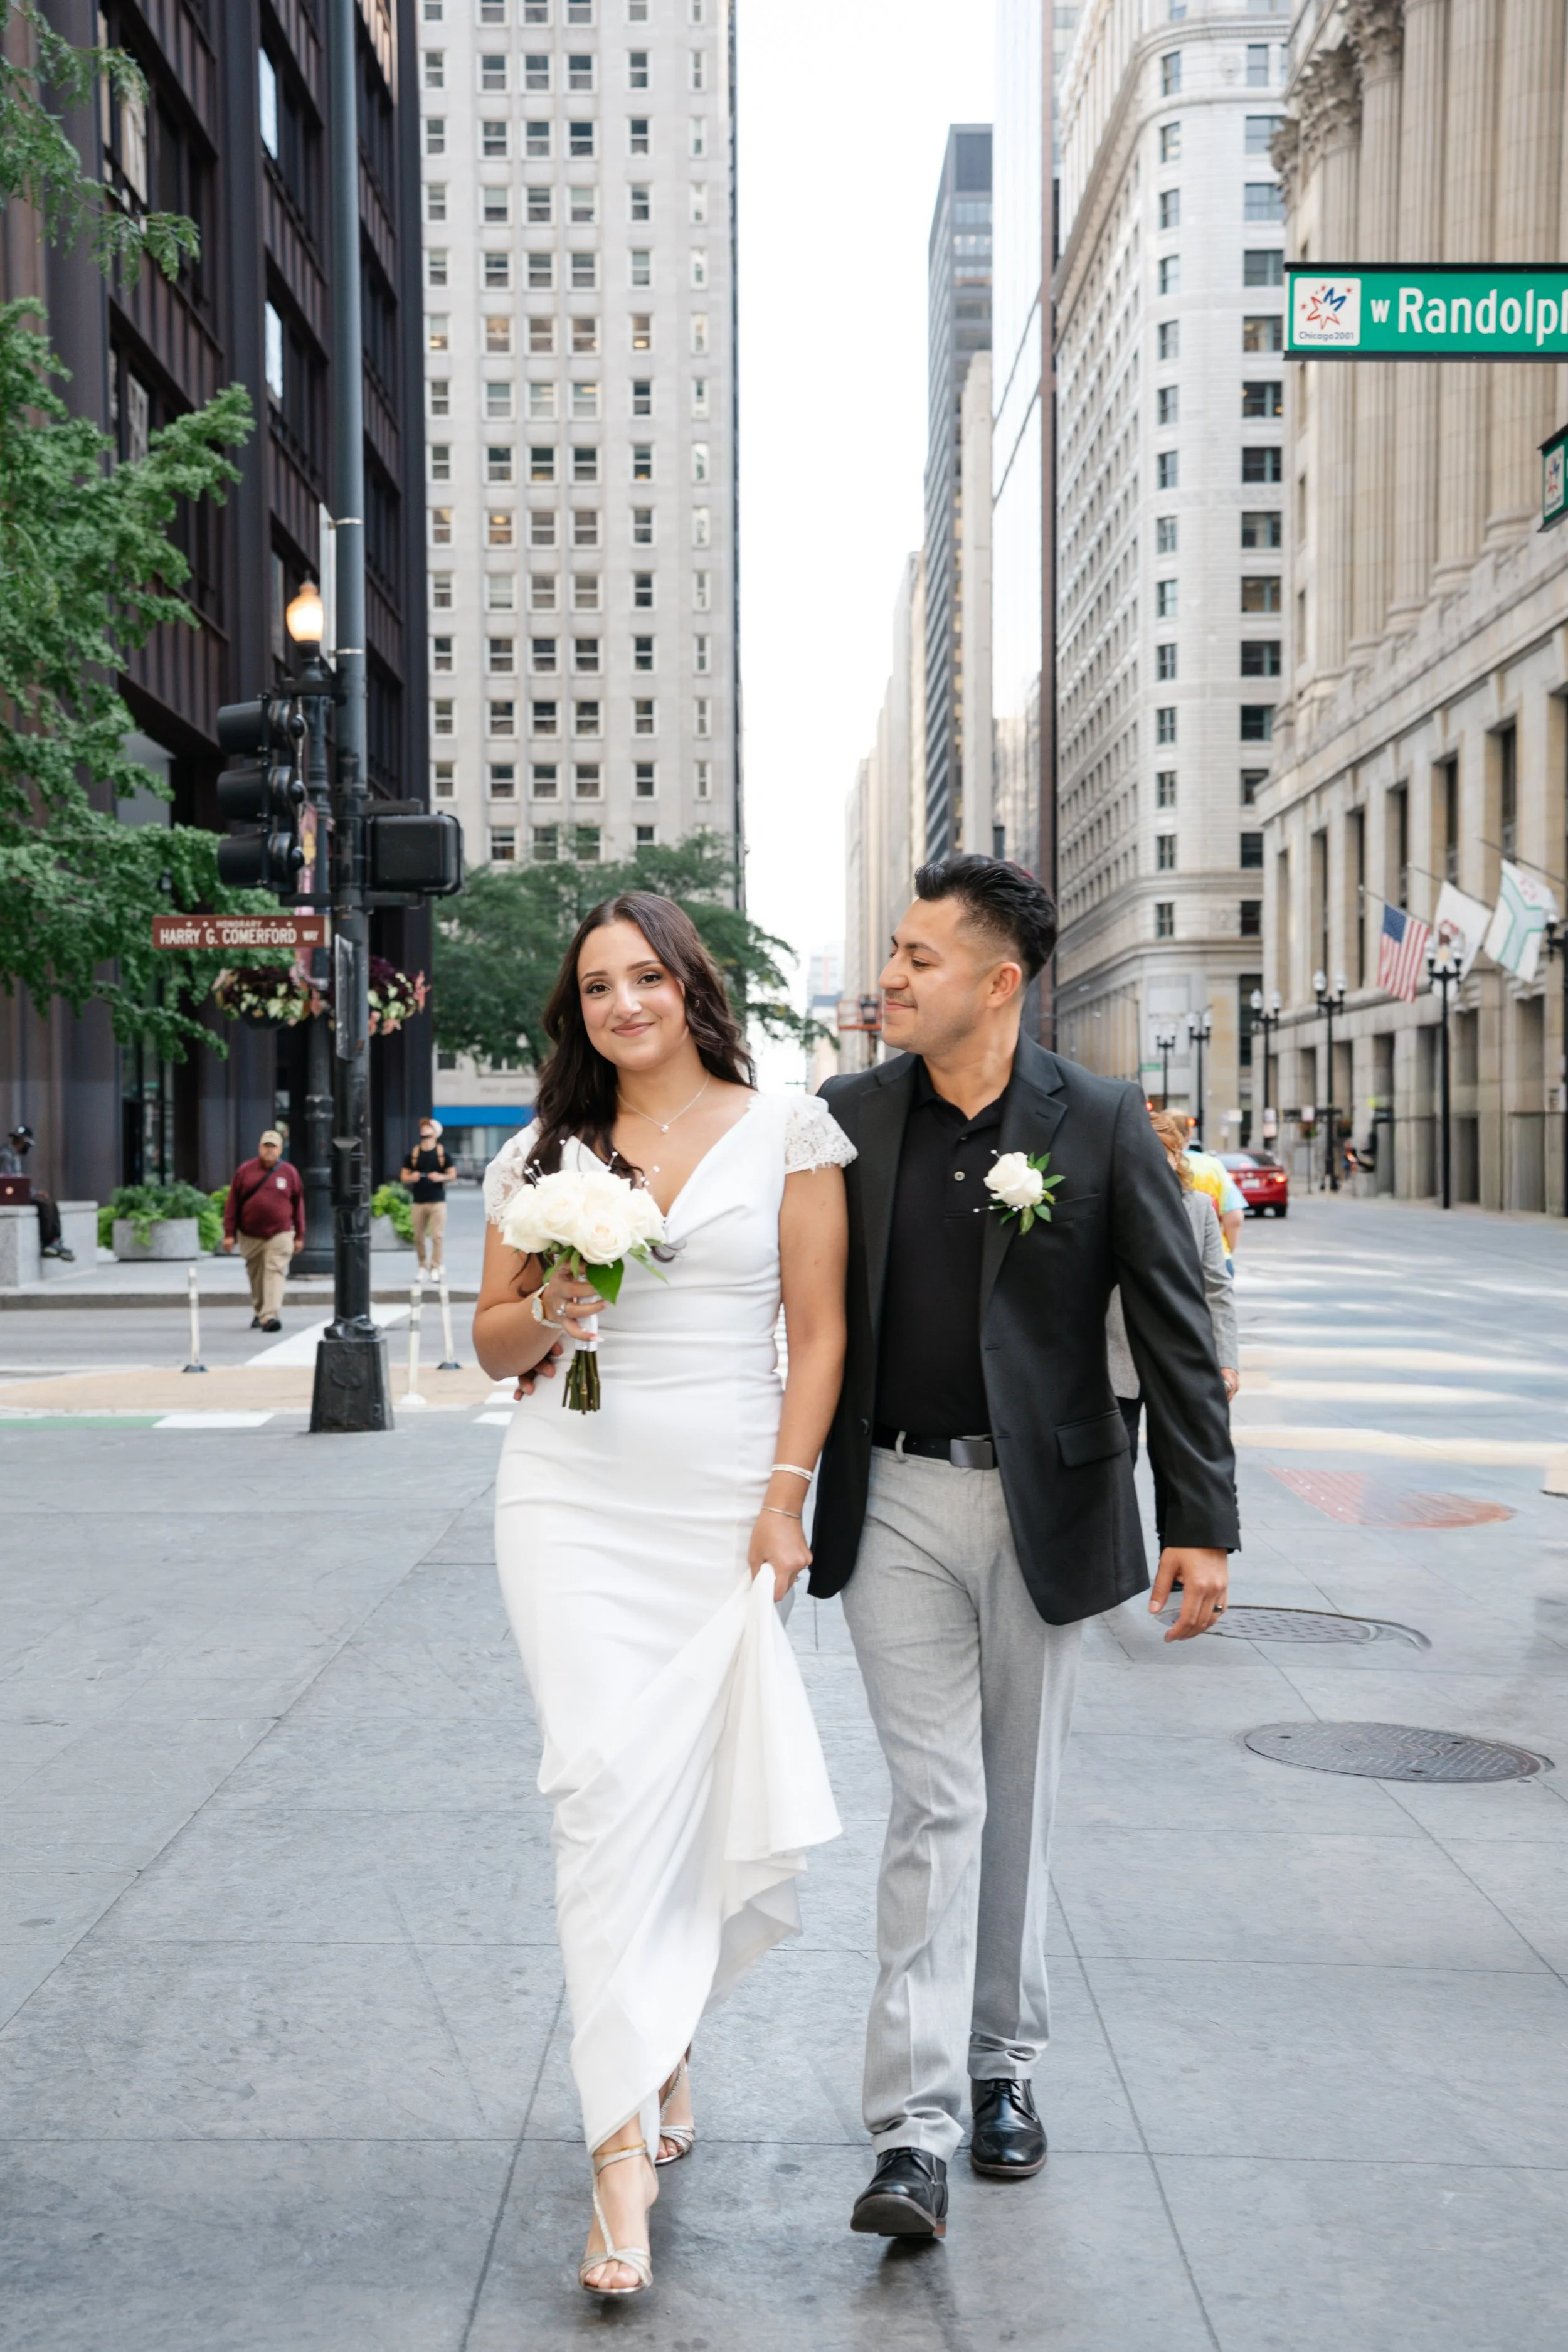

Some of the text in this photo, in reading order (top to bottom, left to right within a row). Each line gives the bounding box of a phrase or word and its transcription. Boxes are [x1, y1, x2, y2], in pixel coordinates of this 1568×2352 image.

[160, 928, 319, 945] HARRY G. COMERFORD WAY
